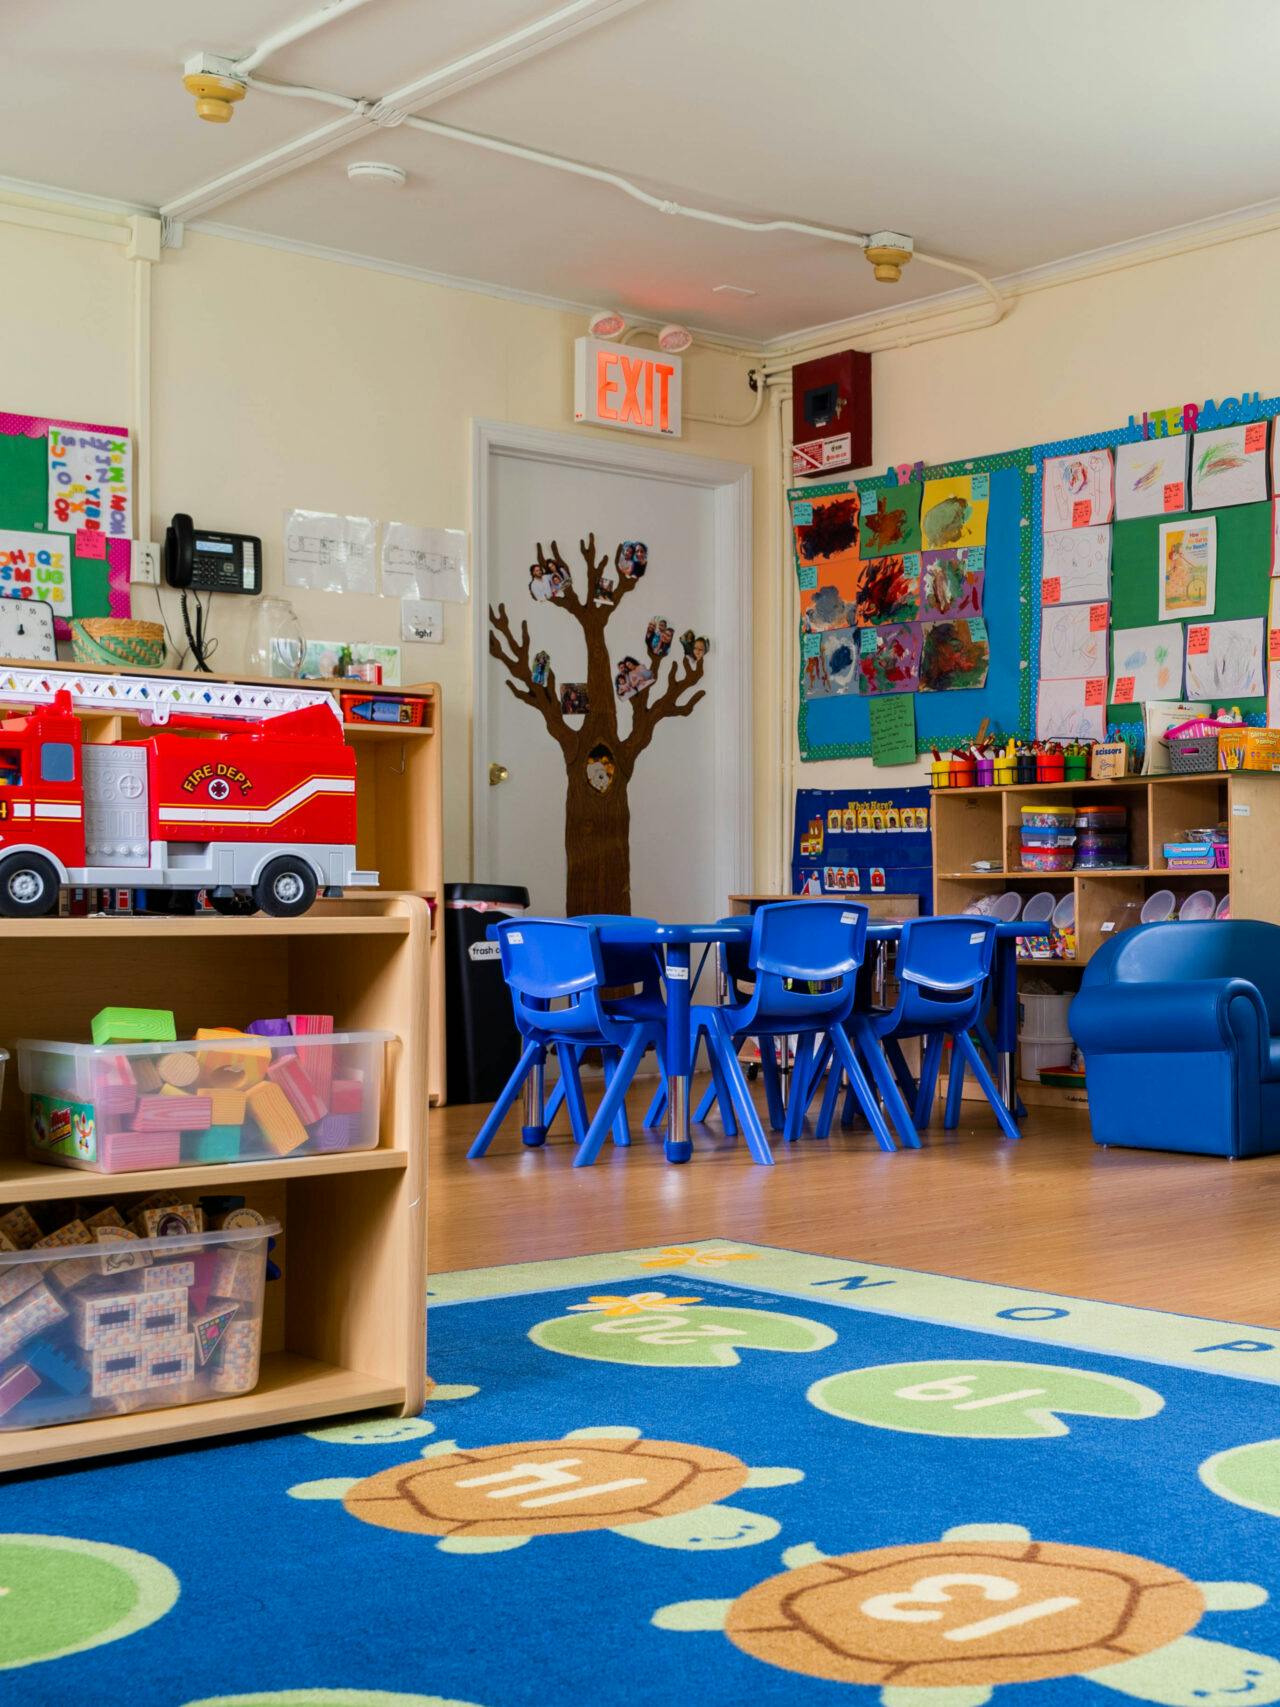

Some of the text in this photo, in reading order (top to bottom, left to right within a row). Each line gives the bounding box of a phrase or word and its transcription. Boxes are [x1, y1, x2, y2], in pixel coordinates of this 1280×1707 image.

[597, 351, 674, 430] EXIT
[886, 461, 924, 489] ART
[415, 628, 432, 638] light
[1096, 748, 1122, 756] scissors
[183, 764, 253, 795] FIRE DEPT.
[472, 946, 494, 955] trash
[591, 1315, 748, 1345] 20
[810, 1275, 897, 1290] N
[1193, 1339, 1276, 1355] P
[894, 1373, 1048, 1411] 19
[454, 1457, 648, 1508] 14
[859, 1572, 1081, 1642] 13
